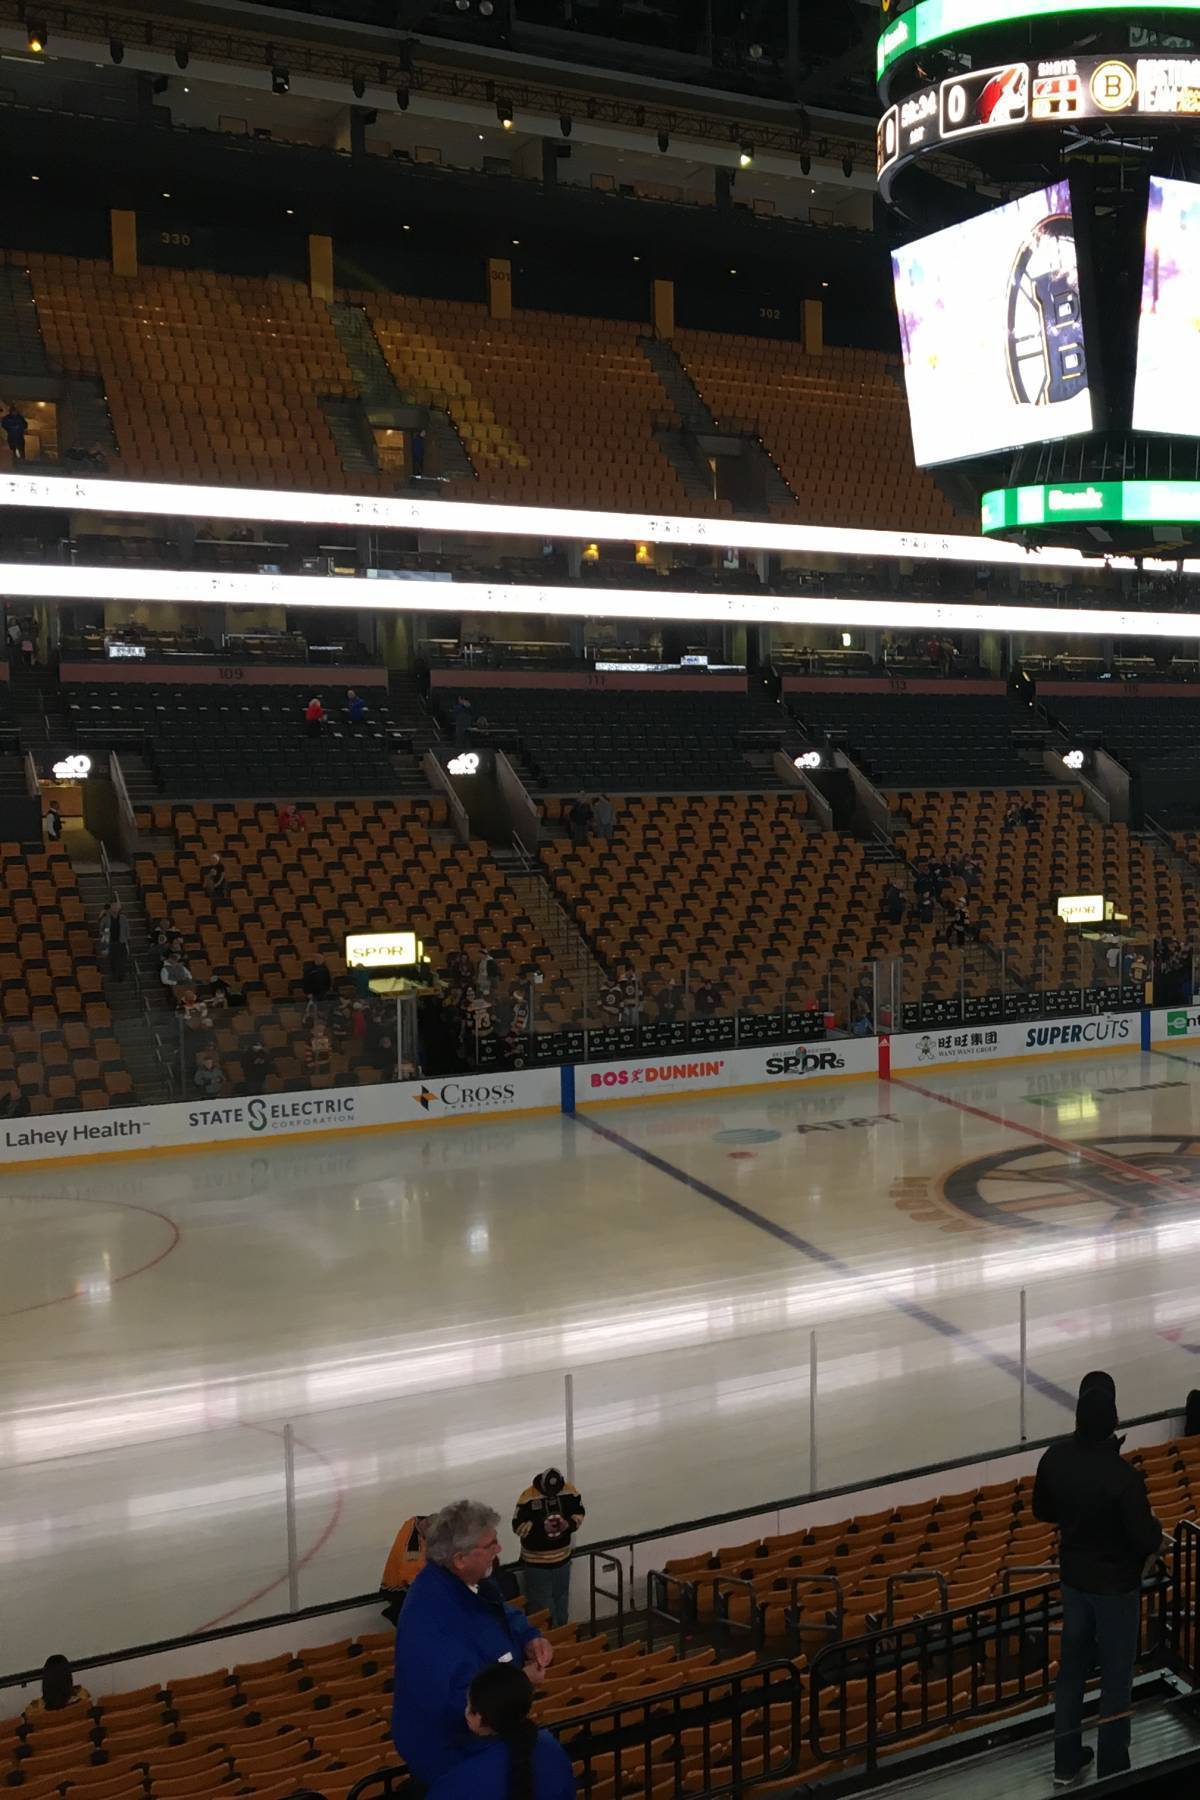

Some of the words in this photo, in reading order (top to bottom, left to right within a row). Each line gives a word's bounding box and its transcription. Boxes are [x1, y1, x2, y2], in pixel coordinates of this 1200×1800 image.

[948, 85, 966, 123] 0
[219, 668, 243, 679] 109
[937, 1031, 998, 1049] 旺旺集团
[1025, 1019, 1129, 1048] SUPERCUTS
[591, 1070, 629, 1088] BOS
[645, 1060, 724, 1082] DUNKIN'
[189, 1109, 243, 1127] STATE
[271, 1098, 355, 1119] ELECTRIC
[6, 1126, 68, 1147] Lahey
